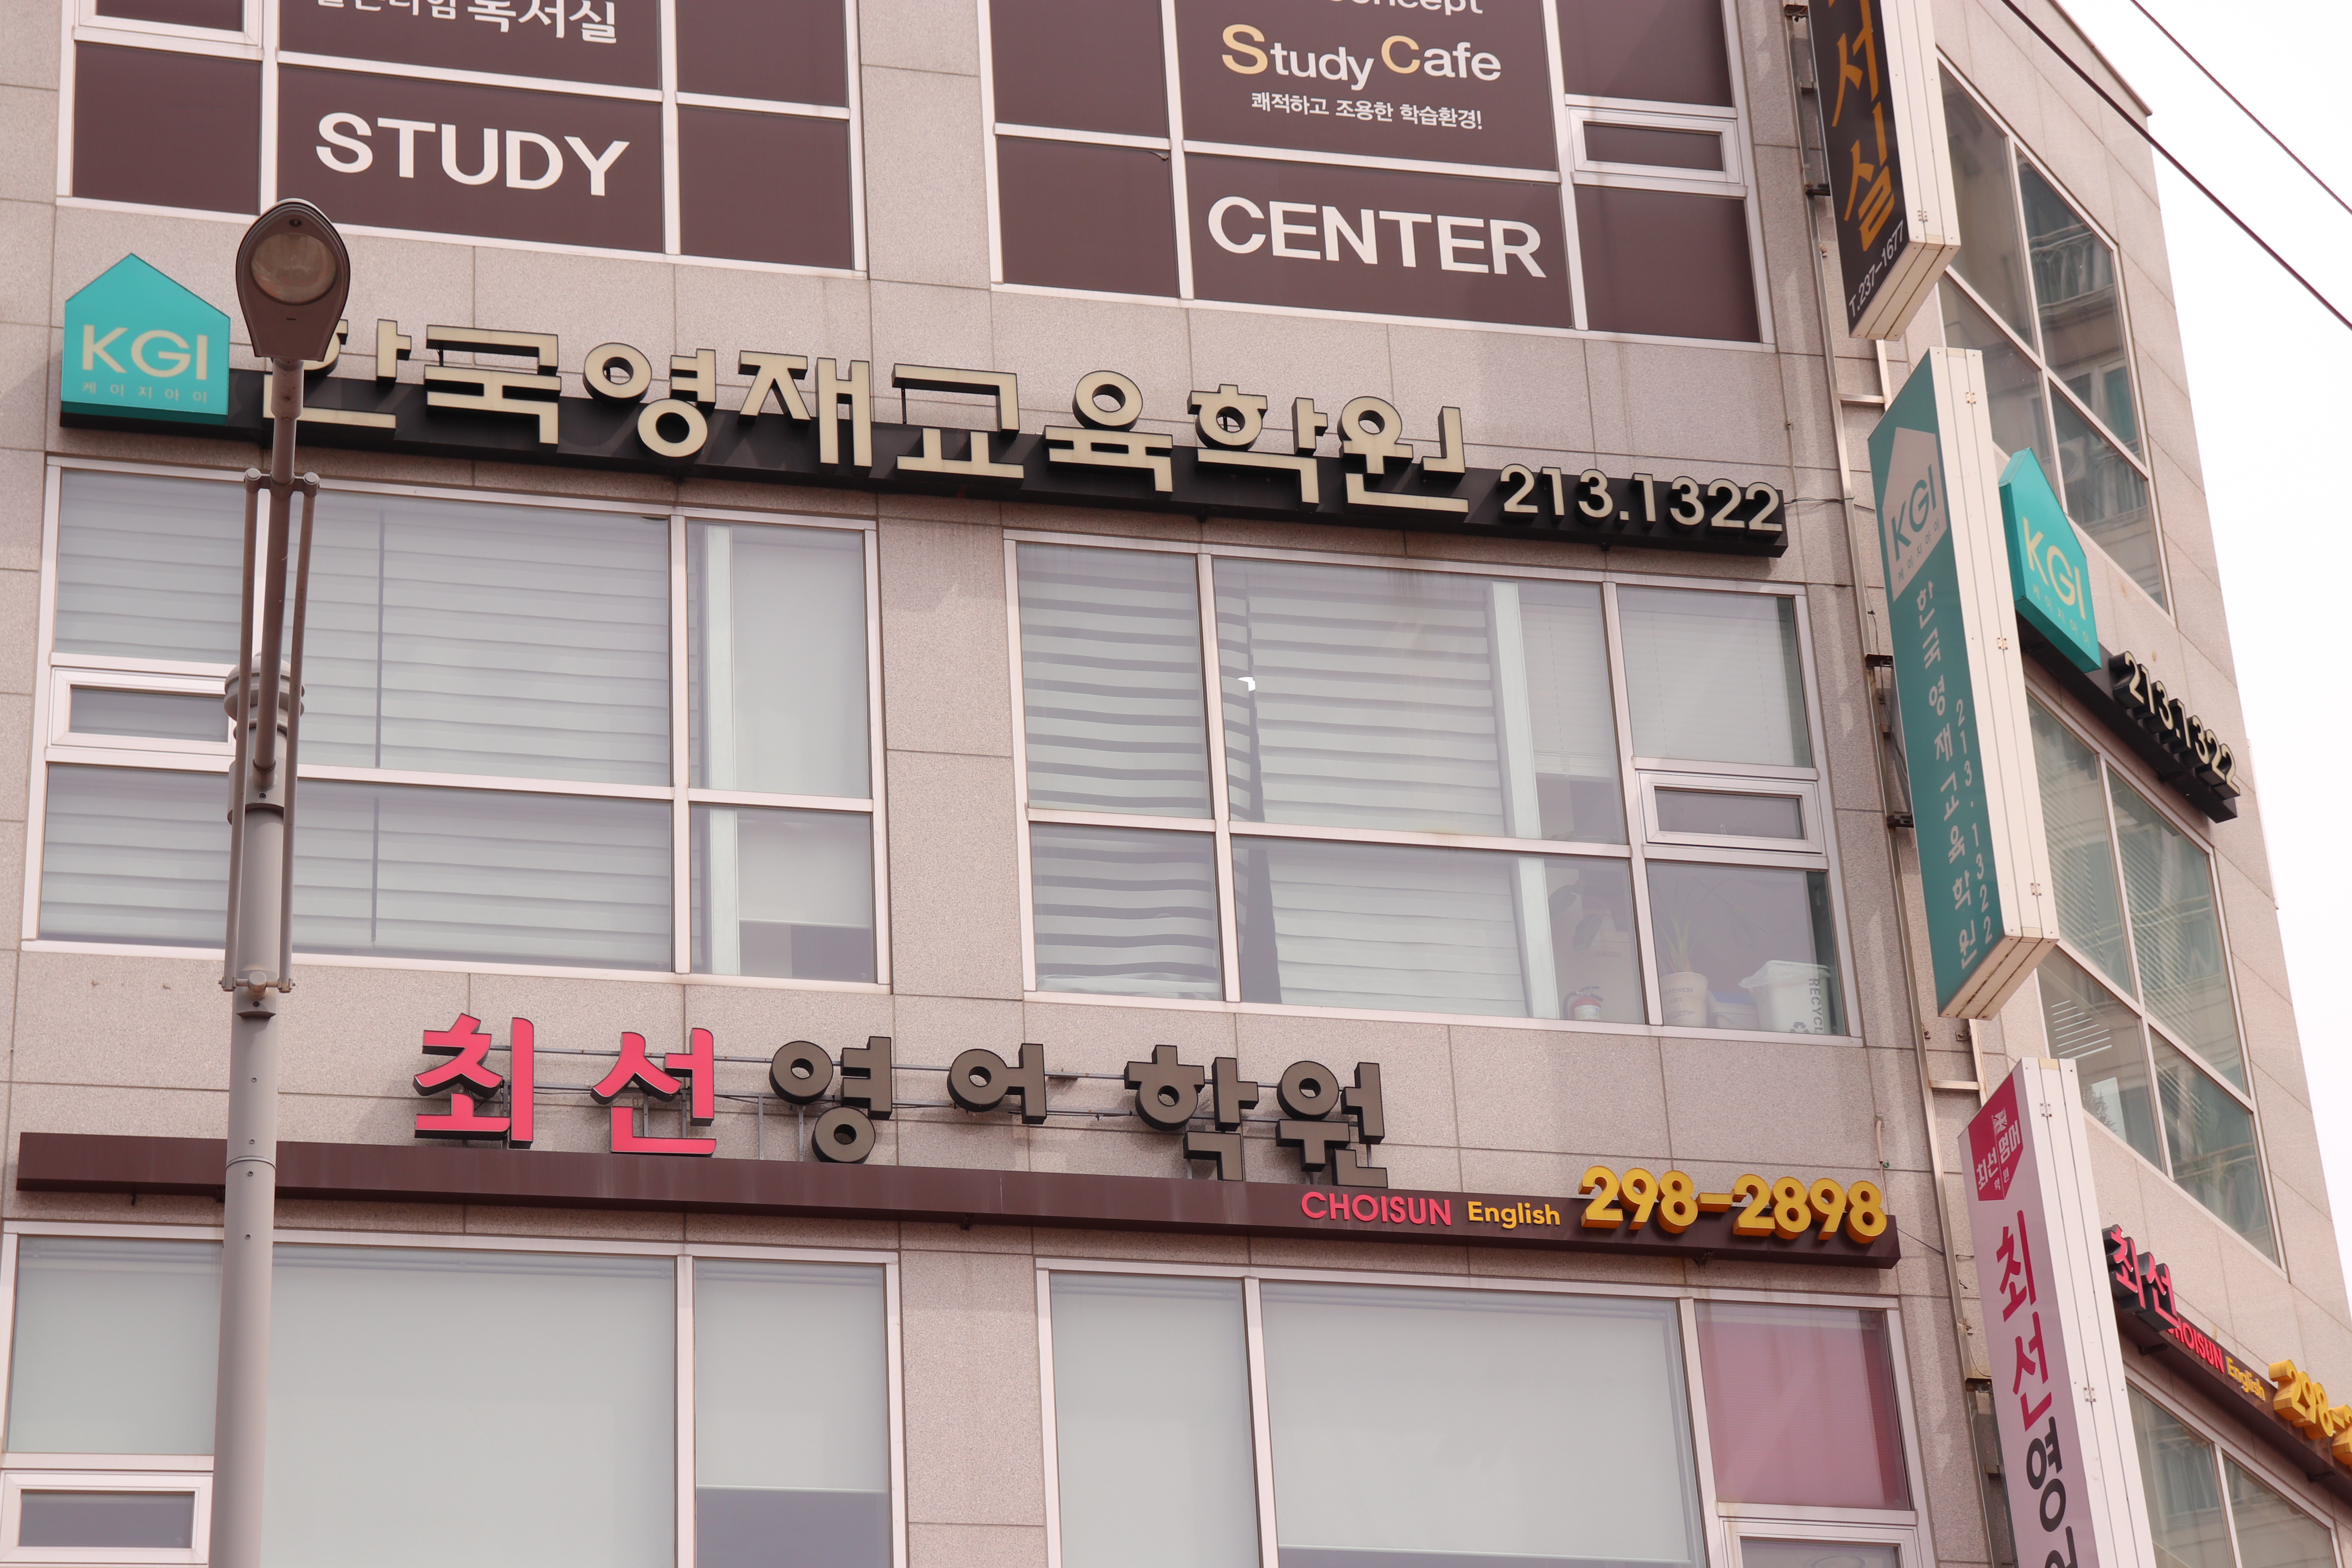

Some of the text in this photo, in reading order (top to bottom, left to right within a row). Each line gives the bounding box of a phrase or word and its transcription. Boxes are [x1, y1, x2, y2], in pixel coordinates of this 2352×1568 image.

[1222, 24, 1501, 91] Study Cafe
[1252, 92, 1482, 130] 쾌적하고 조용한 학습환경!
[316, 113, 630, 196] STUDY
[1208, 196, 1546, 278] CENTER
[83, 324, 208, 380] KGI
[1501, 464, 1784, 534] 213.1322
[1891, 463, 1937, 562] KGI
[2022, 516, 2086, 621] KGI
[2123, 651, 2240, 797] 213.1322
[1301, 1166, 1887, 1244] CHOISUN English 298-2898
[2166, 1318, 2225, 1374] HOISUN
[2226, 1356, 2266, 1402] English
